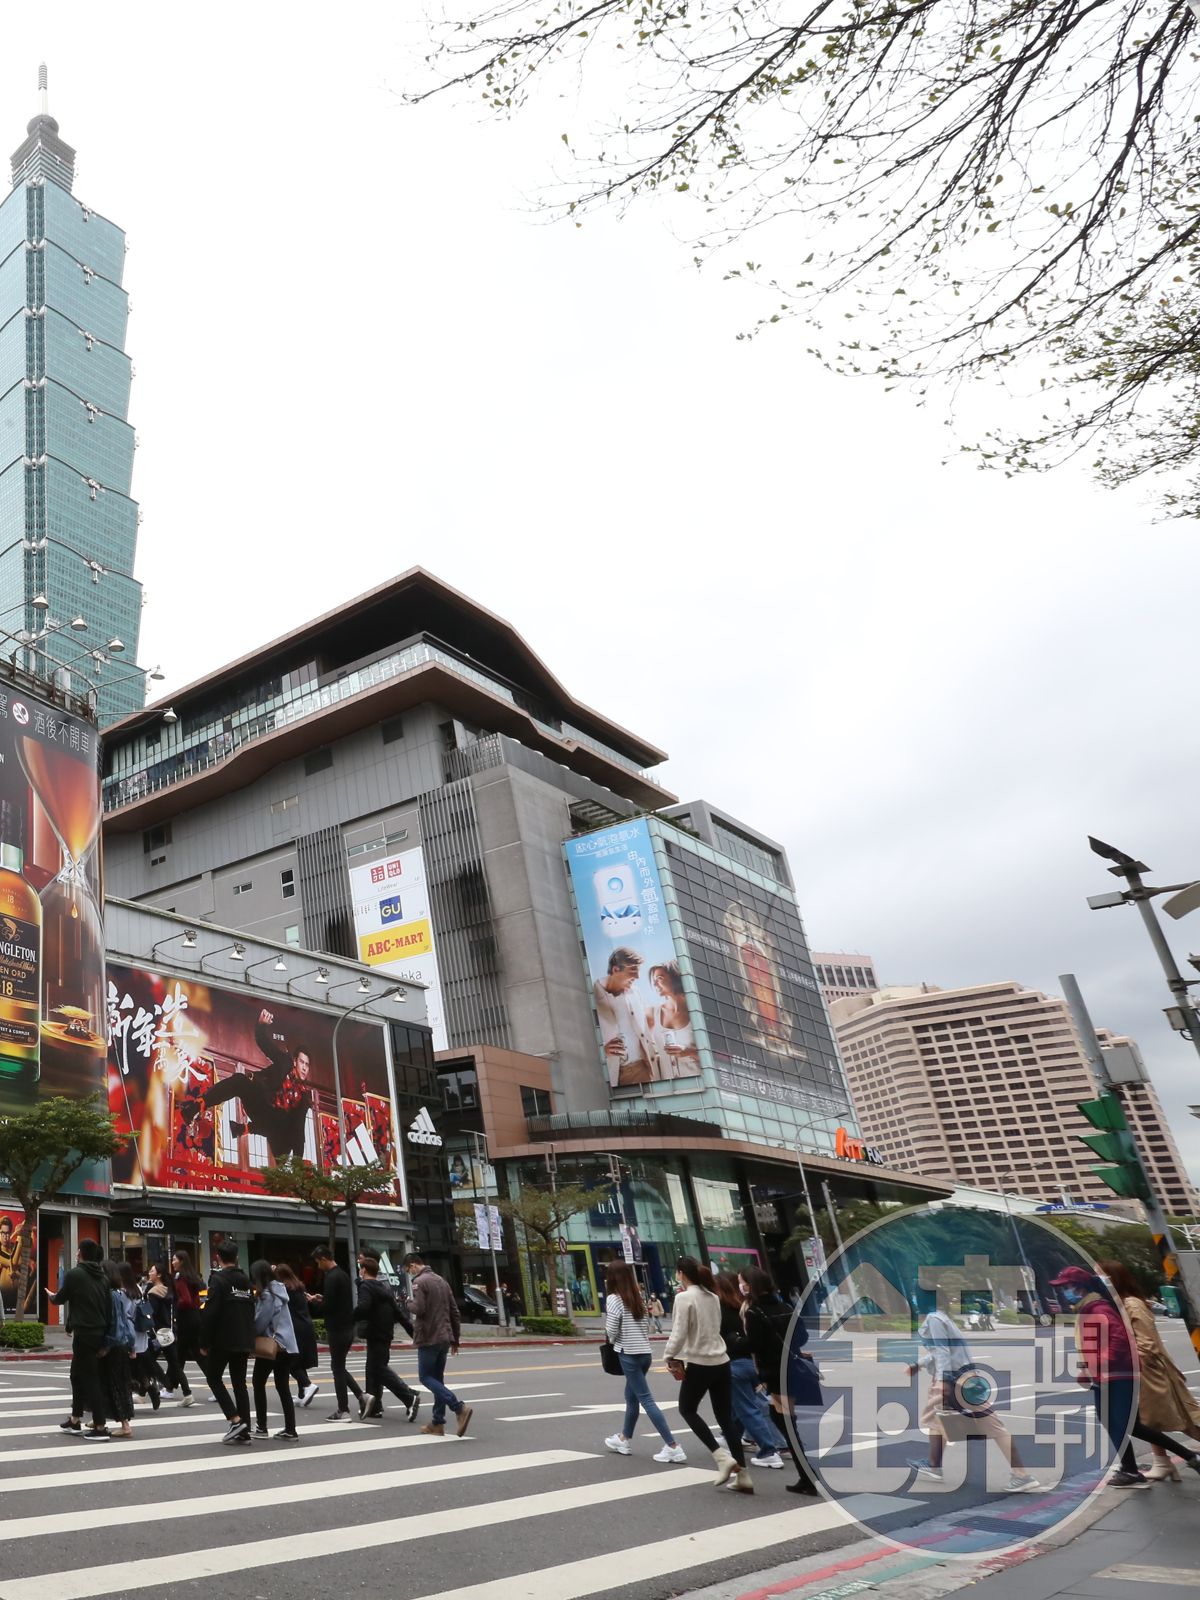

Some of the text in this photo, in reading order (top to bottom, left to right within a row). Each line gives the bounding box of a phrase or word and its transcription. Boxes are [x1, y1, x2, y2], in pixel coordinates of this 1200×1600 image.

[34, 708, 90, 754] 酒後不開車
[381, 903, 400, 917] GU
[368, 932, 423, 957] ABC-MART
[2, 980, 13, 996] 18
[408, 1130, 442, 1146] adidas
[132, 1218, 164, 1229] SEIKO
